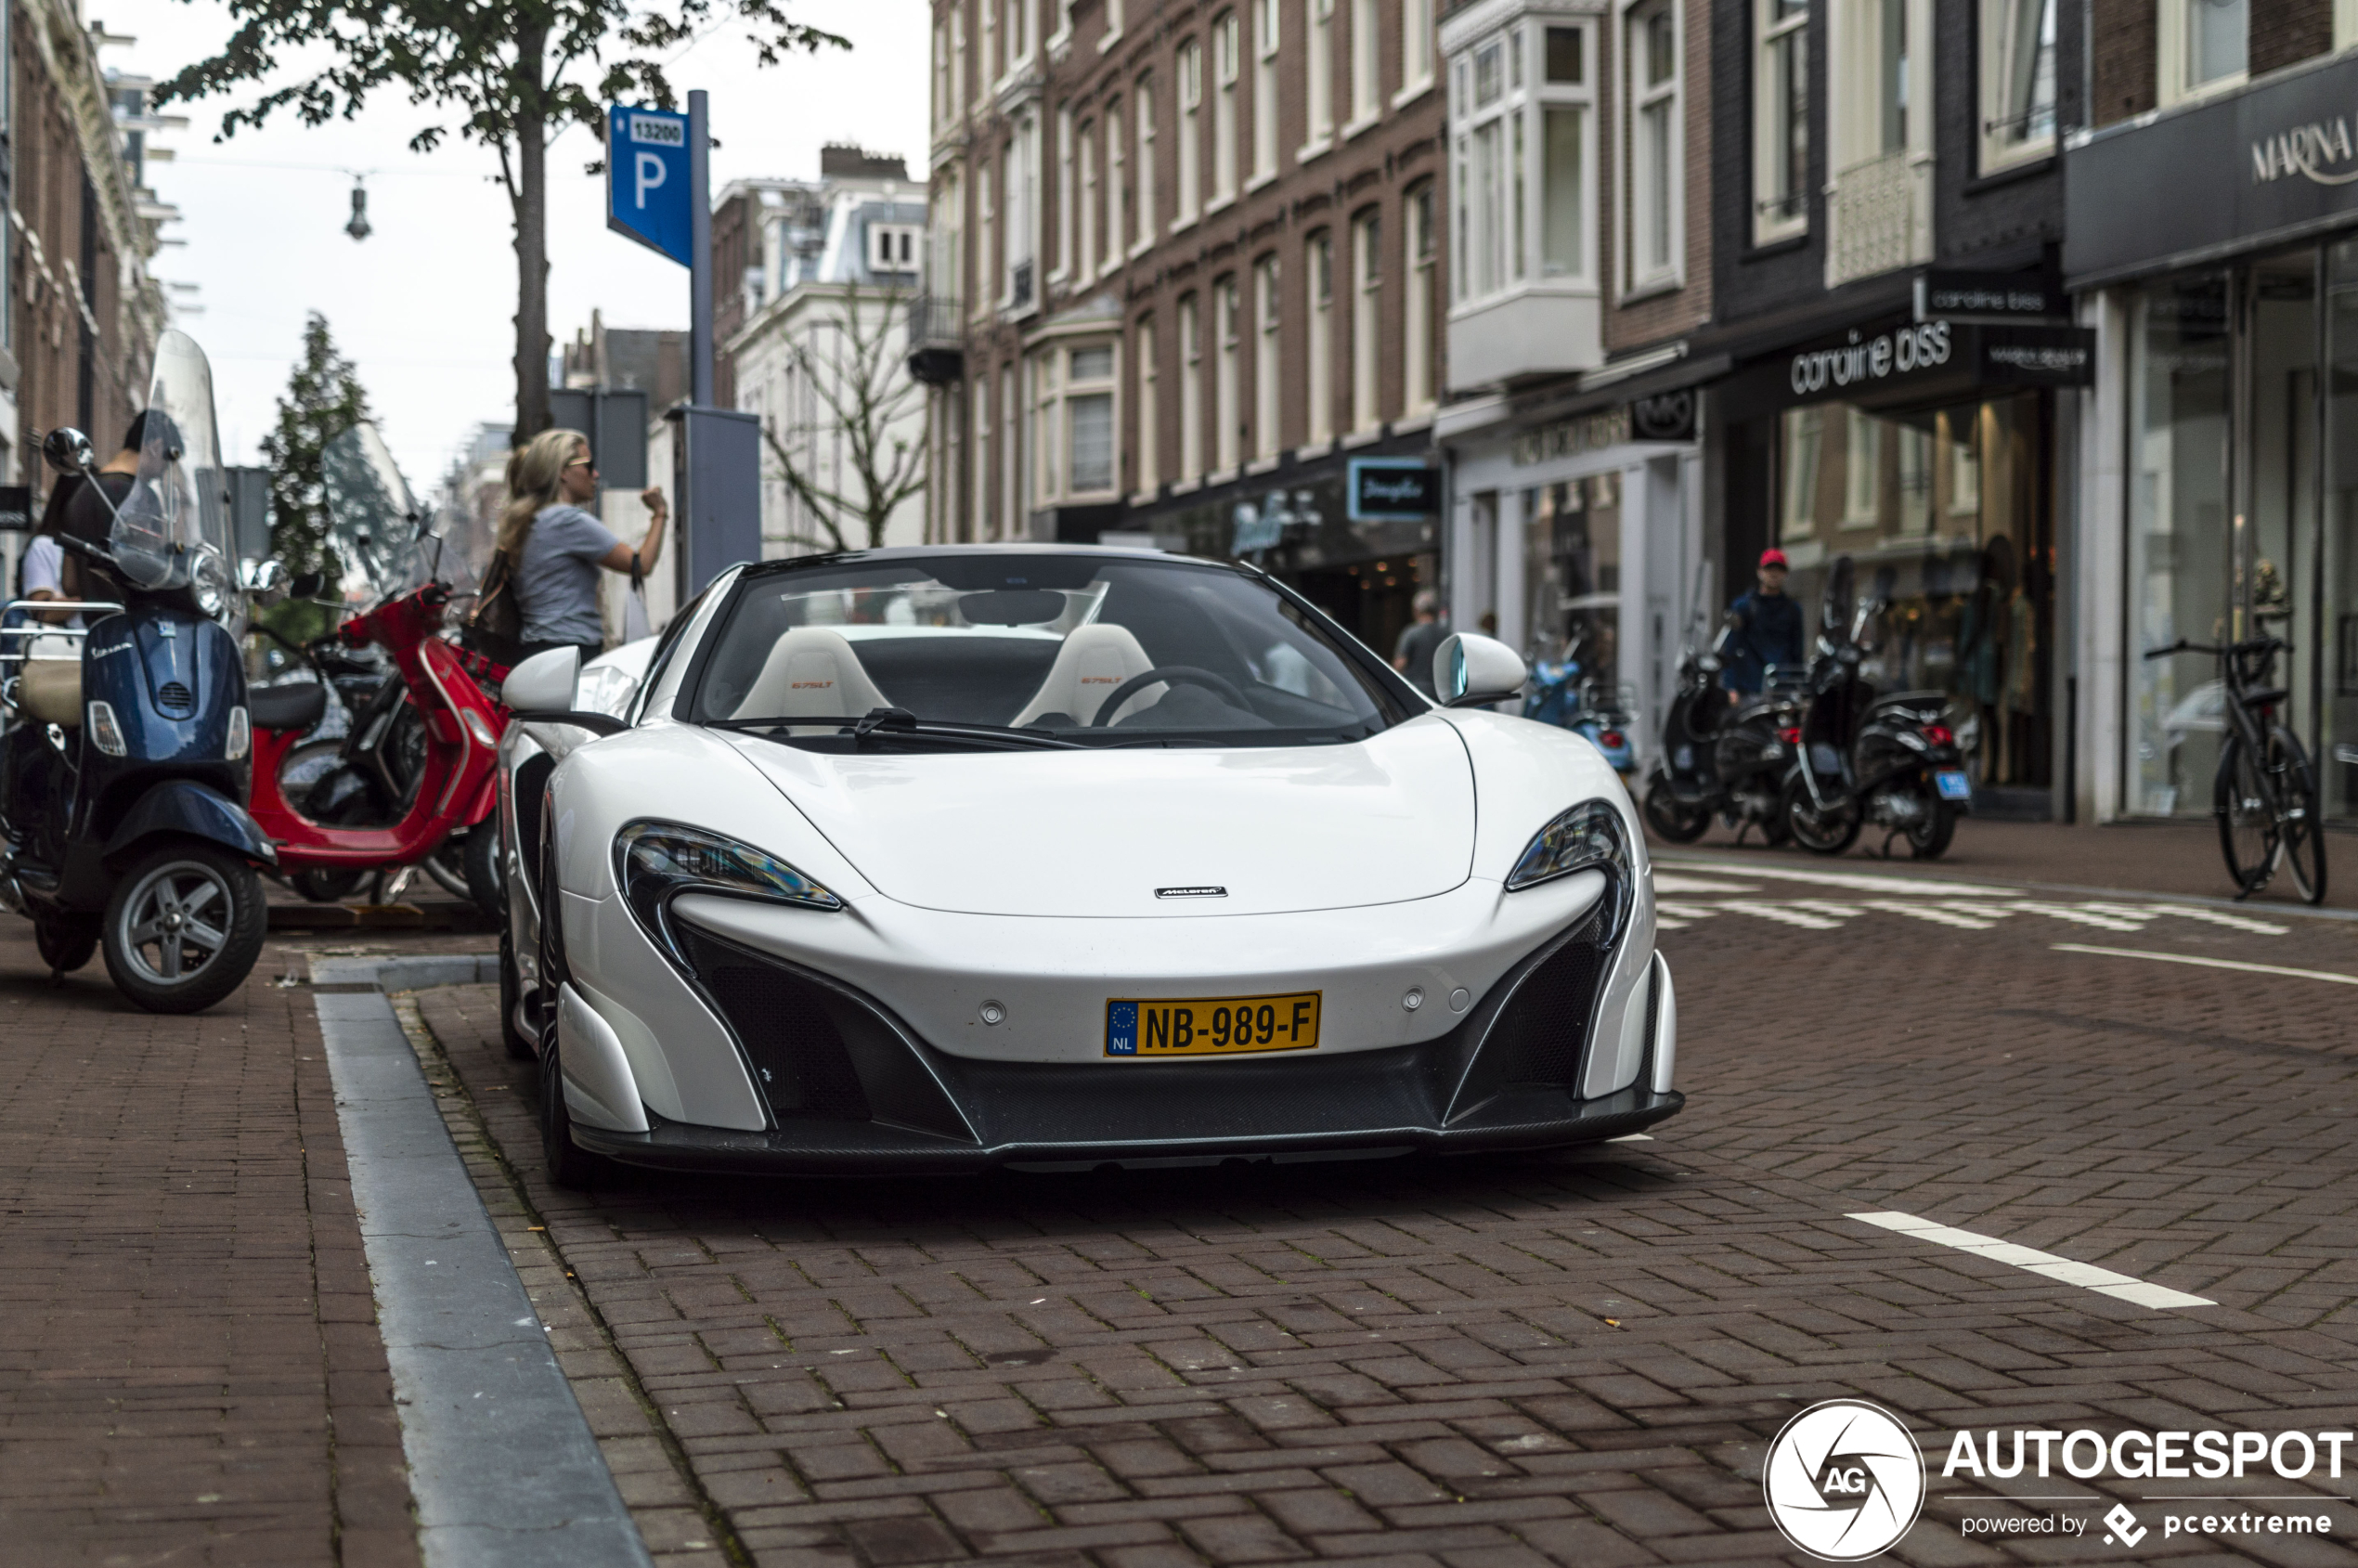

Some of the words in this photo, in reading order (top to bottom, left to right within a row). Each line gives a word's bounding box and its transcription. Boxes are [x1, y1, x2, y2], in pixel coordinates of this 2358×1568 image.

[635, 122, 680, 143] 13200
[635, 150, 667, 210] P
[1146, 1002, 1311, 1049] NB-989-F
[1113, 1037, 1132, 1050] NL
